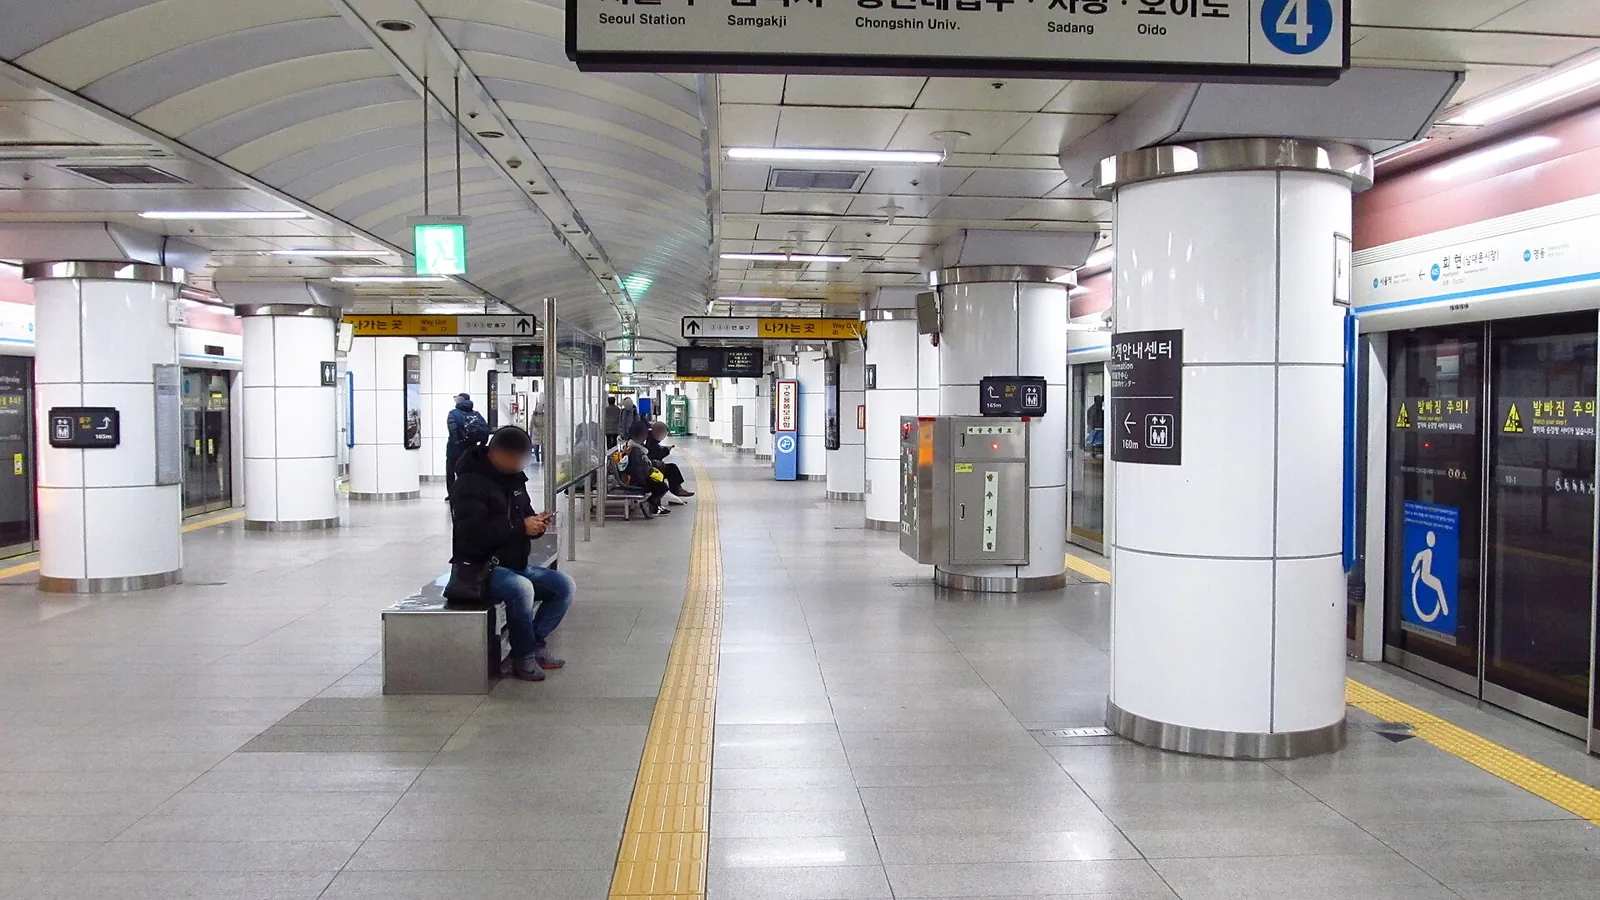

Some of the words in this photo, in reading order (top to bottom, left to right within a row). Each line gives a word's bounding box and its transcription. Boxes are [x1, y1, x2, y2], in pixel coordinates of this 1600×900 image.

[599, 13, 635, 25] Seoul
[639, 13, 685, 25] Station
[727, 15, 787, 28] Samgakji
[855, 17, 924, 30] Chongshin
[928, 19, 960, 31] Univ.
[1047, 22, 1094, 34] Sadang
[1138, 24, 1167, 35] Oido
[1275, 0, 1312, 46] 4
[391, 320, 402, 332] 곳
[765, 322, 801, 333] 나가는
[804, 322, 815, 333] 곳
[832, 322, 845, 330] Way
[1417, 400, 1442, 414] 발빠짐
[1446, 400, 1469, 414] 주의!
[1532, 400, 1565, 417] 발빠짐
